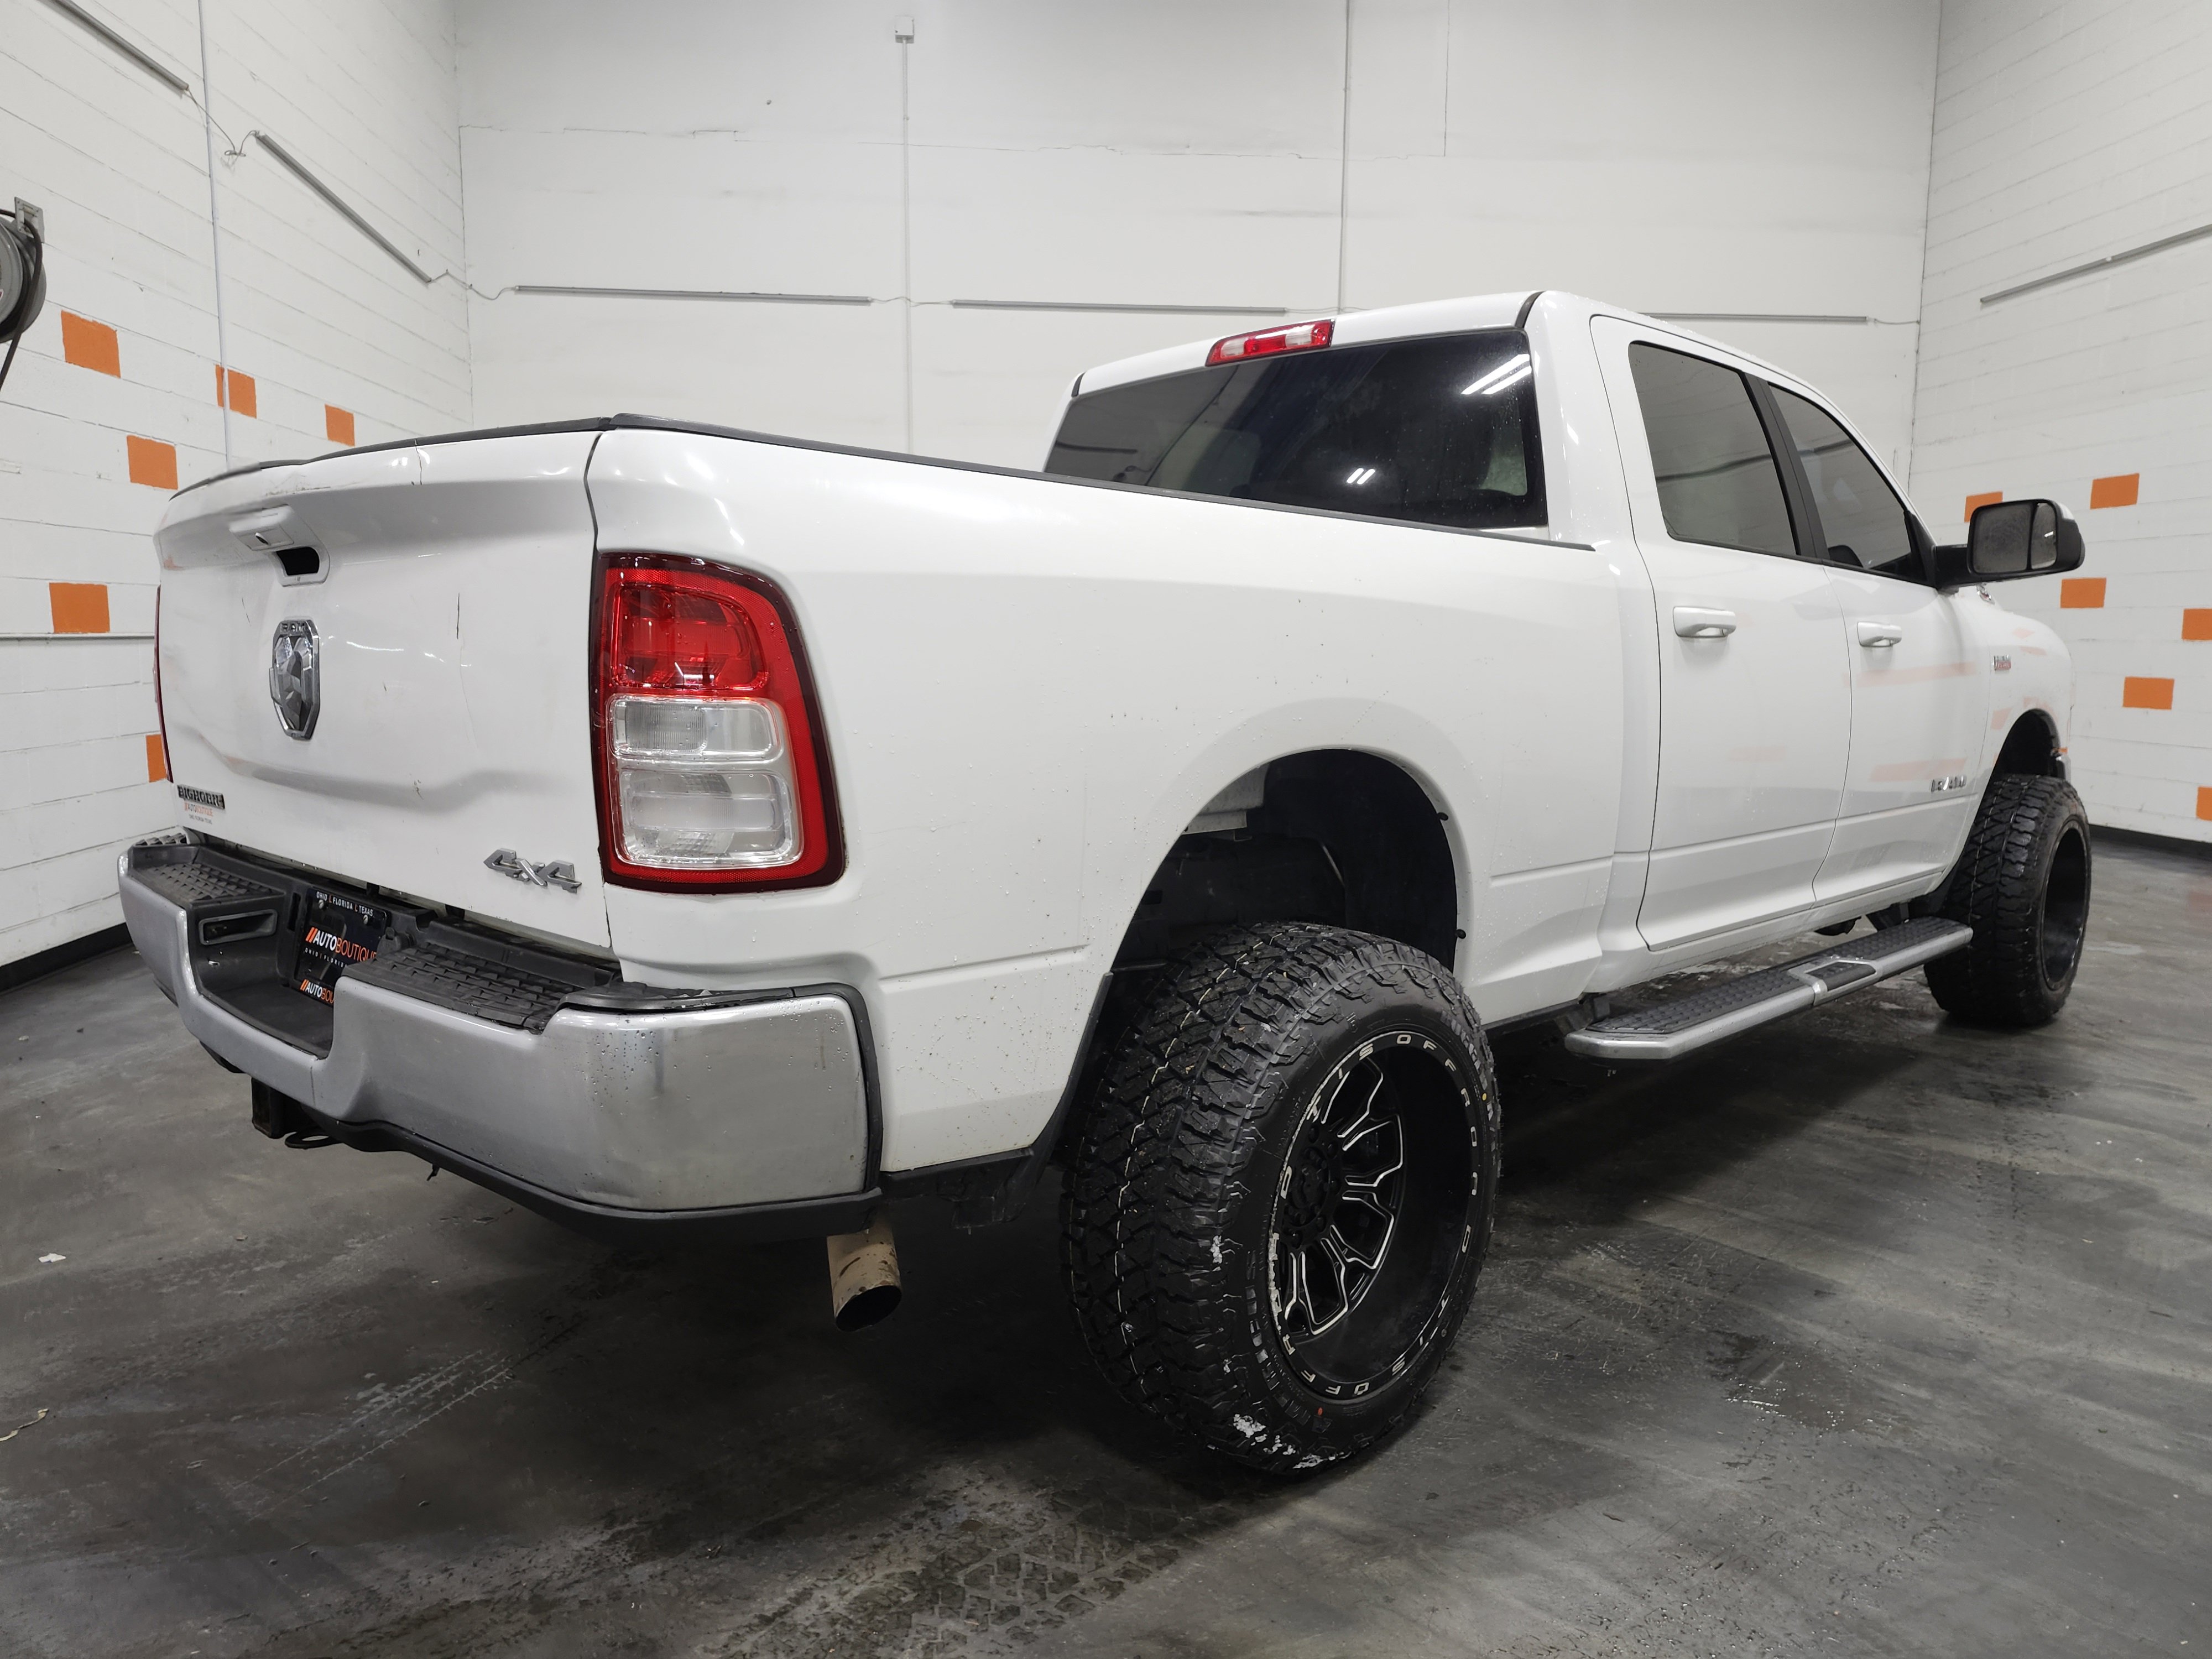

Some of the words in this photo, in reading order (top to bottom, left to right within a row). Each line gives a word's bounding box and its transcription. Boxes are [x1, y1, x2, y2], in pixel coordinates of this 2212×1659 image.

[280, 623, 305, 633] RAM
[316, 891, 327, 901] OHIO
[333, 898, 353, 910] FLORIDA
[359, 905, 373, 916] TEXAS
[305, 947, 318, 957] OHIO
